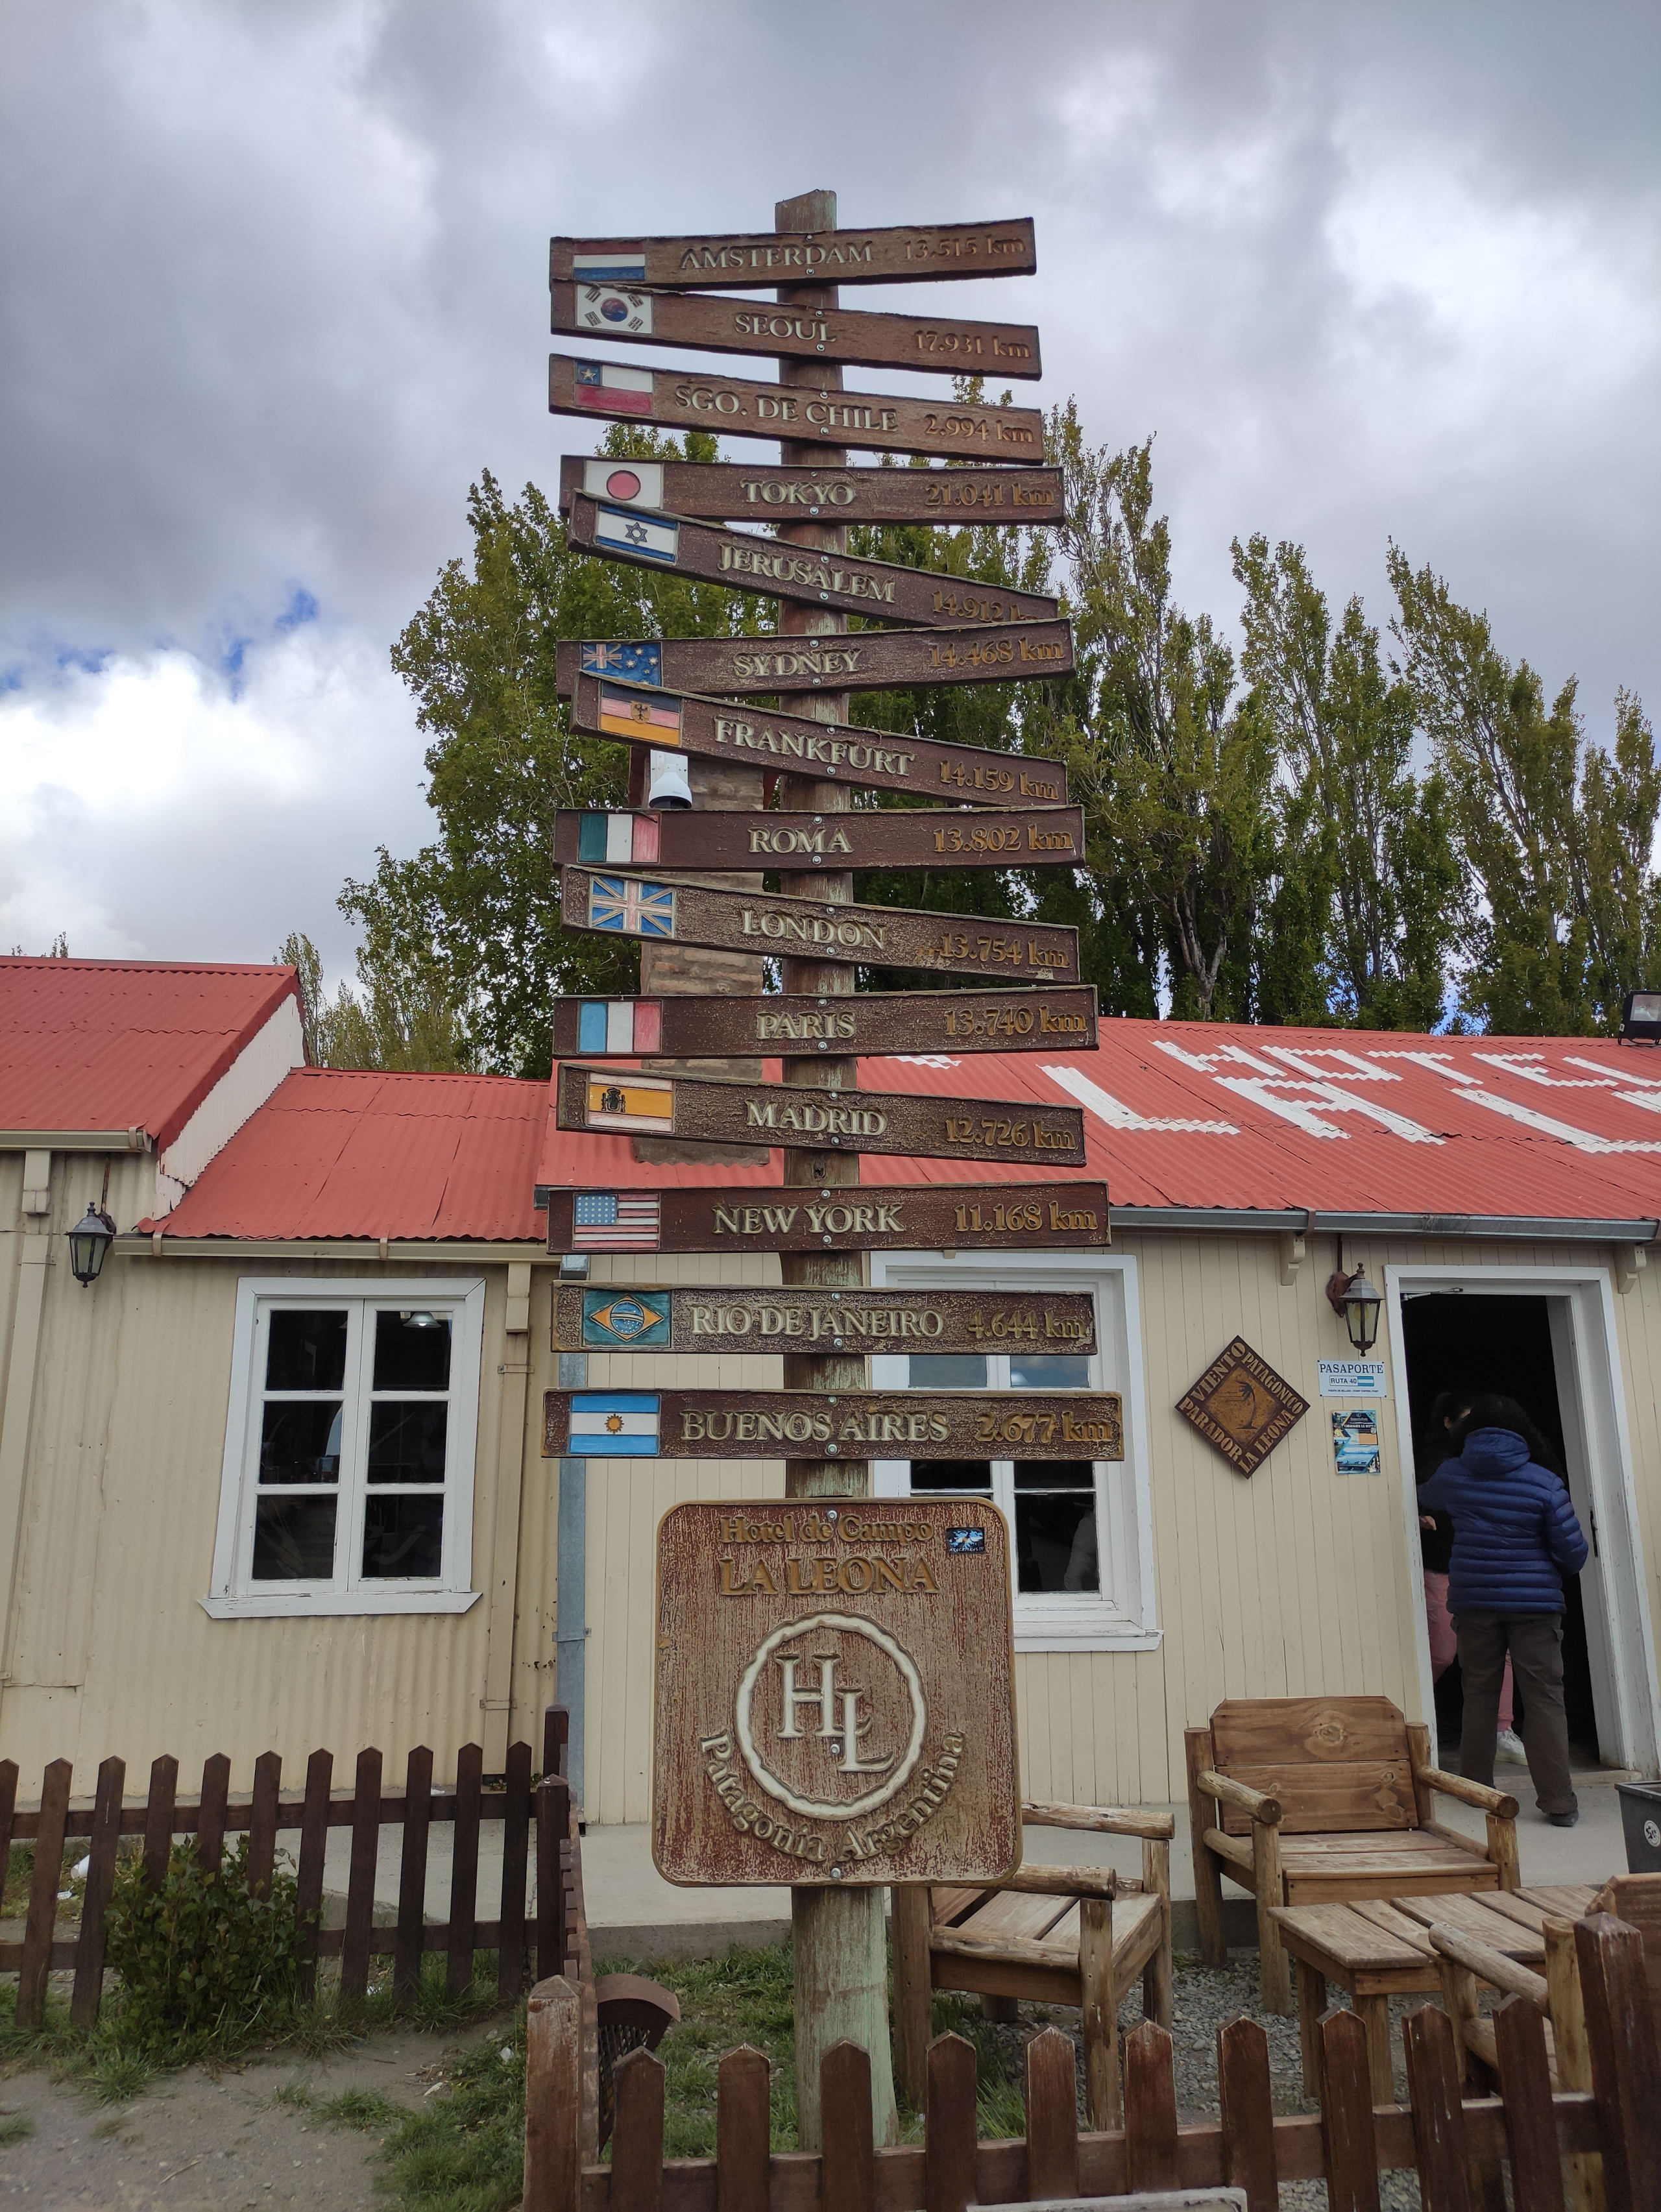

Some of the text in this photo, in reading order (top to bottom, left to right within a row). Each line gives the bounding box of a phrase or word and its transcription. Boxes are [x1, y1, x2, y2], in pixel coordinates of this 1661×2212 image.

[680, 234, 1026, 270] AMSTERDAM 13.515 km
[734, 312, 1032, 358] SEOUL 17.931 km
[675, 385, 1036, 443] SGO. DE CHILE 2.994 km
[740, 479, 1056, 508] TOKYO 21.041 km
[717, 541, 897, 604] JERUSALEM
[931, 590, 1004, 623] 14.912
[733, 637, 1065, 677] SYDNEY 14.468 km
[714, 715, 1060, 800] FRANKFURT 14.159 km
[747, 823, 1074, 854] ROMA 13.802 km
[742, 908, 1071, 968] LONDON 13.754 km
[756, 1006, 1087, 1039] PARIS 13.740 km
[746, 1099, 1077, 1150] MADRID 12.726 km
[1036, 1064, 1447, 1146] LA
[712, 1200, 1098, 1234] NEW YORK 11.168 km
[690, 1303, 1086, 1341] RIO DE JANEIRO 4.644 km
[1191, 1342, 1246, 1402] VIENTO
[1241, 1352, 1303, 1415] PATAGONICO
[1320, 1364, 1384, 1374] PASAPORTE
[681, 1409, 1114, 1444] BUENOS AIRES 2.677 km
[1180, 1396, 1243, 1462] PARADOR
[1238, 1409, 1295, 1474] LA LEONA
[720, 1514, 934, 1546] Hotel de Campo
[718, 1557, 940, 1596] LA LEONA
[700, 1729, 966, 1862] Patagonia Argentina
